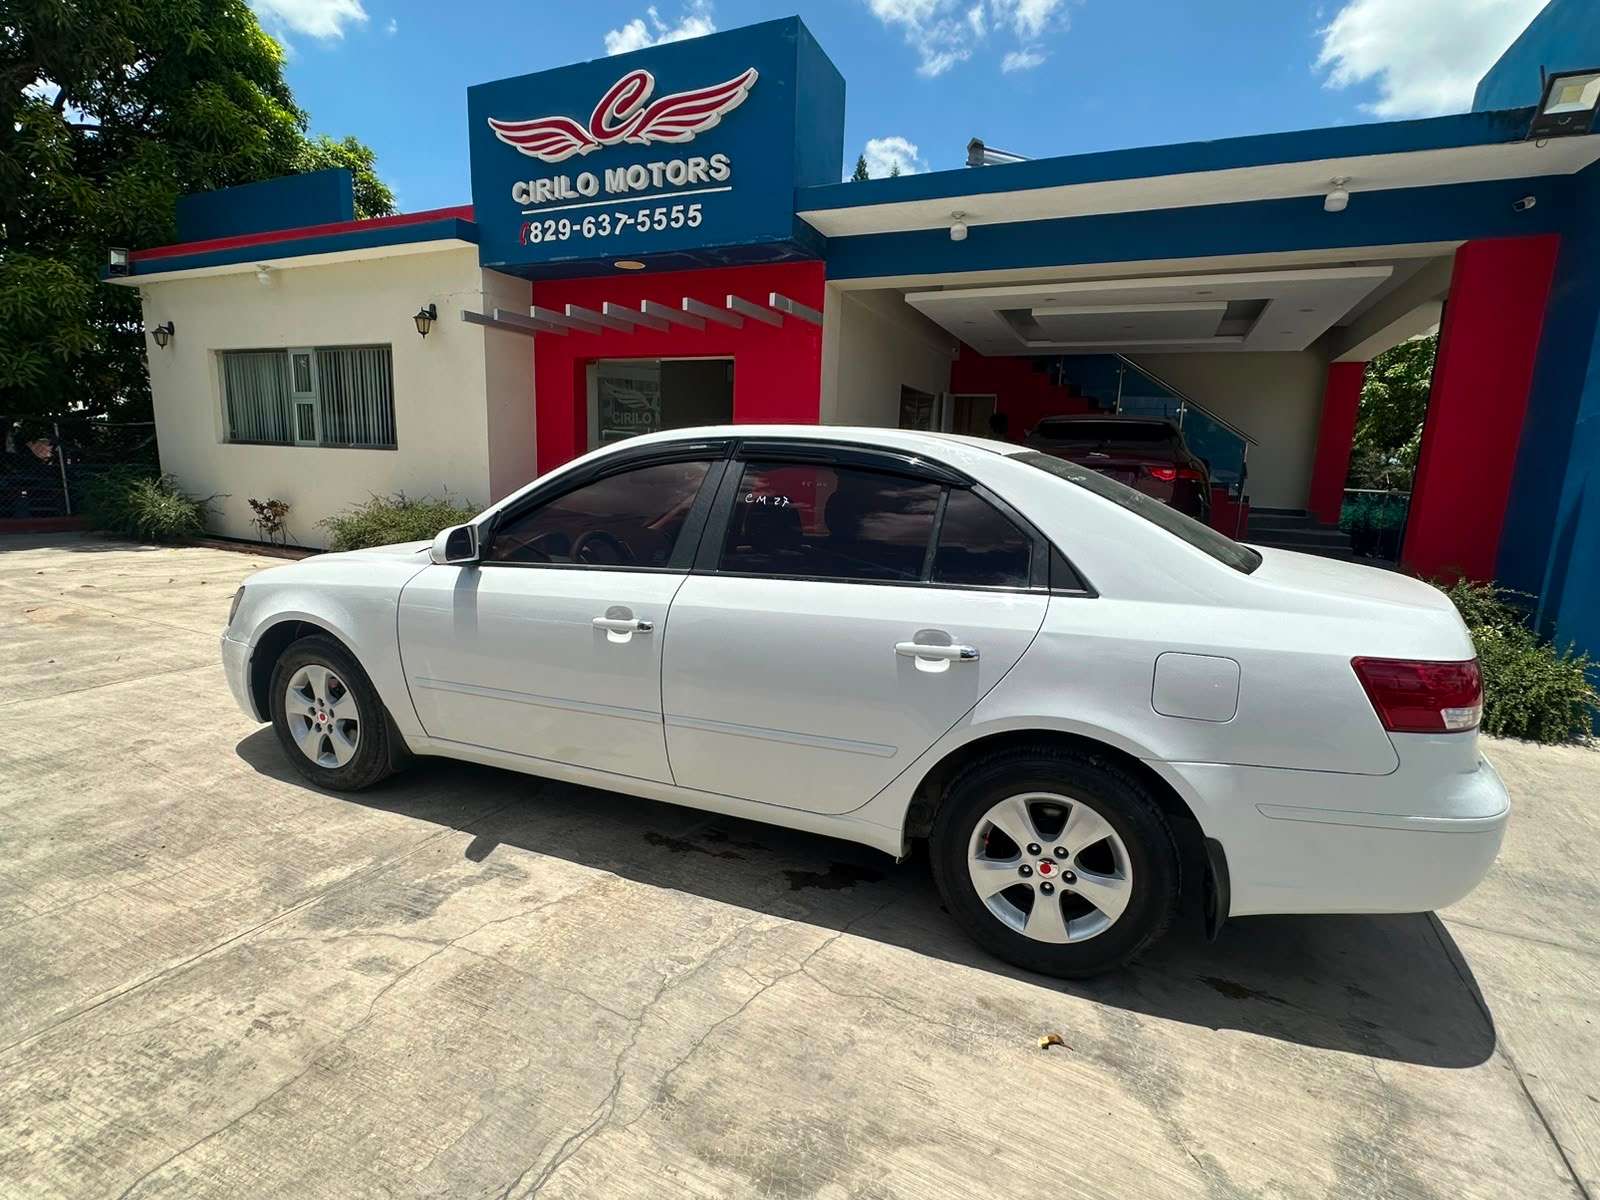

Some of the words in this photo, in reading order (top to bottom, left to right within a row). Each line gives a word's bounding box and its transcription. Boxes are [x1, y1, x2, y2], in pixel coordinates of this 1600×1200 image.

[511, 171, 600, 205] CIRILO
[605, 153, 732, 194] MOTORS
[529, 204, 703, 244] 829-637-5555
[612, 411, 651, 425] CIRILO
[745, 493, 767, 505] CM
